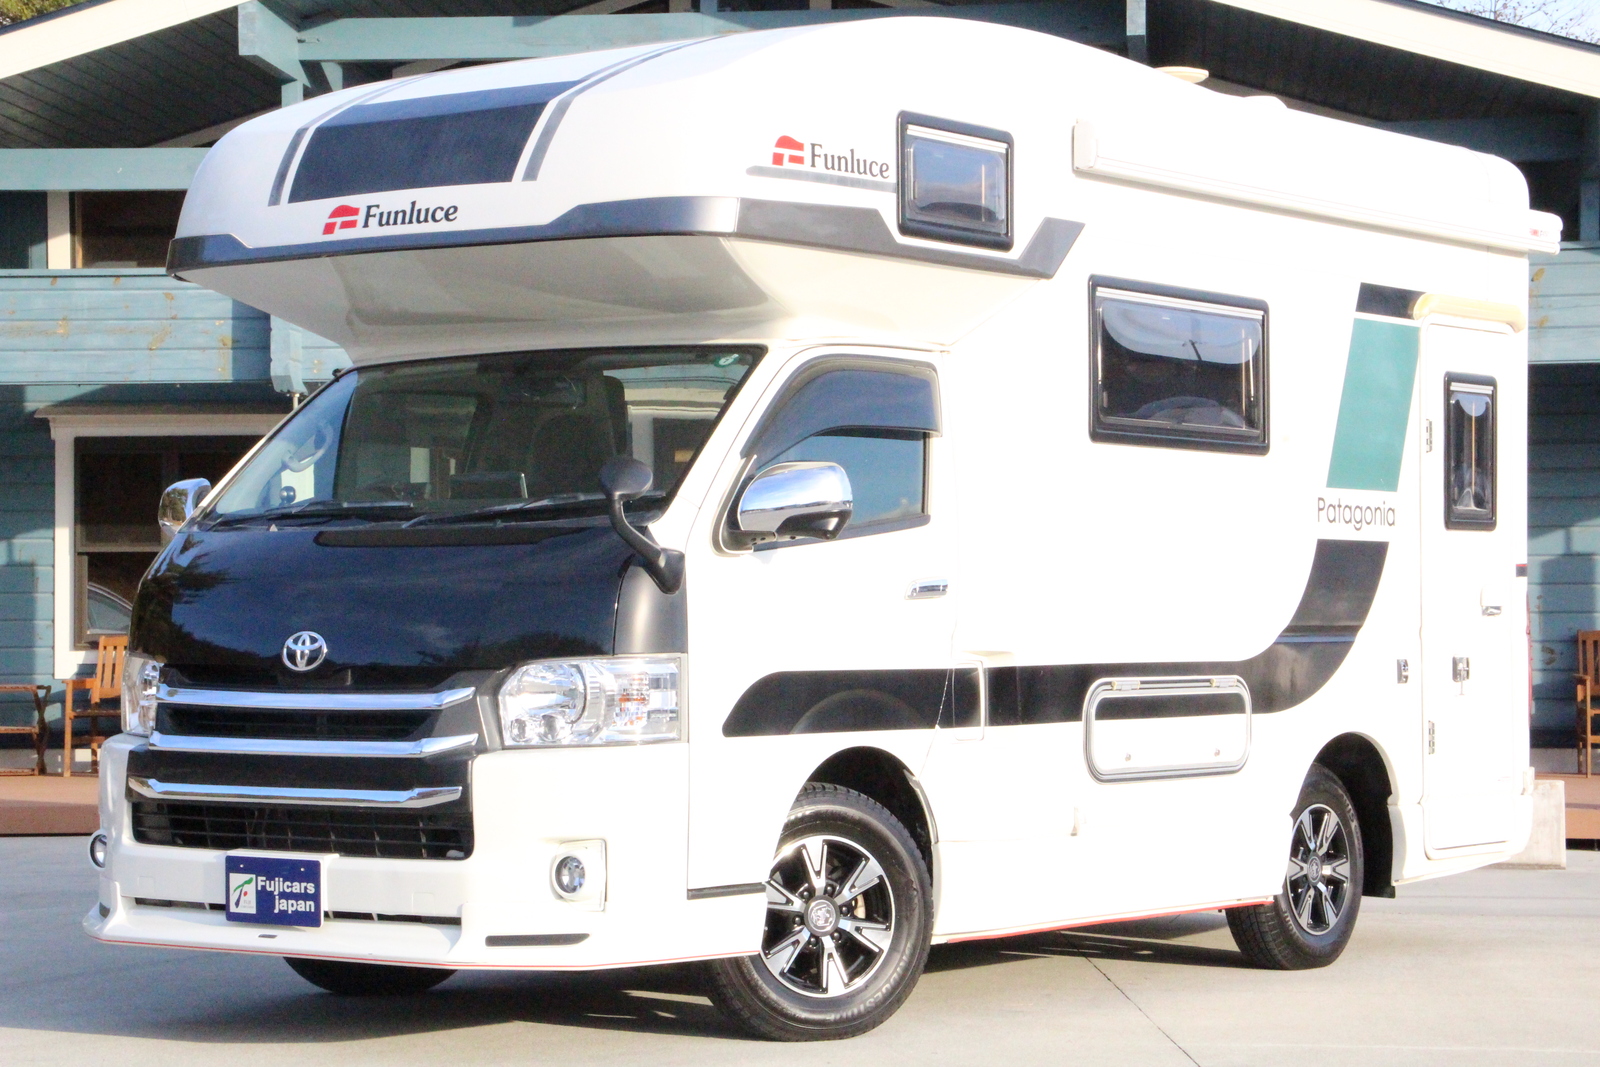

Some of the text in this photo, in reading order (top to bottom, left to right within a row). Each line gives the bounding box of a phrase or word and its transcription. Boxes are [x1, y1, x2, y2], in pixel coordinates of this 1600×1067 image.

[810, 143, 889, 179] Funluce
[362, 200, 458, 228] Funluce
[1317, 497, 1395, 531] Patagonia
[257, 876, 315, 895] Fujicars
[274, 895, 315, 913] japan
